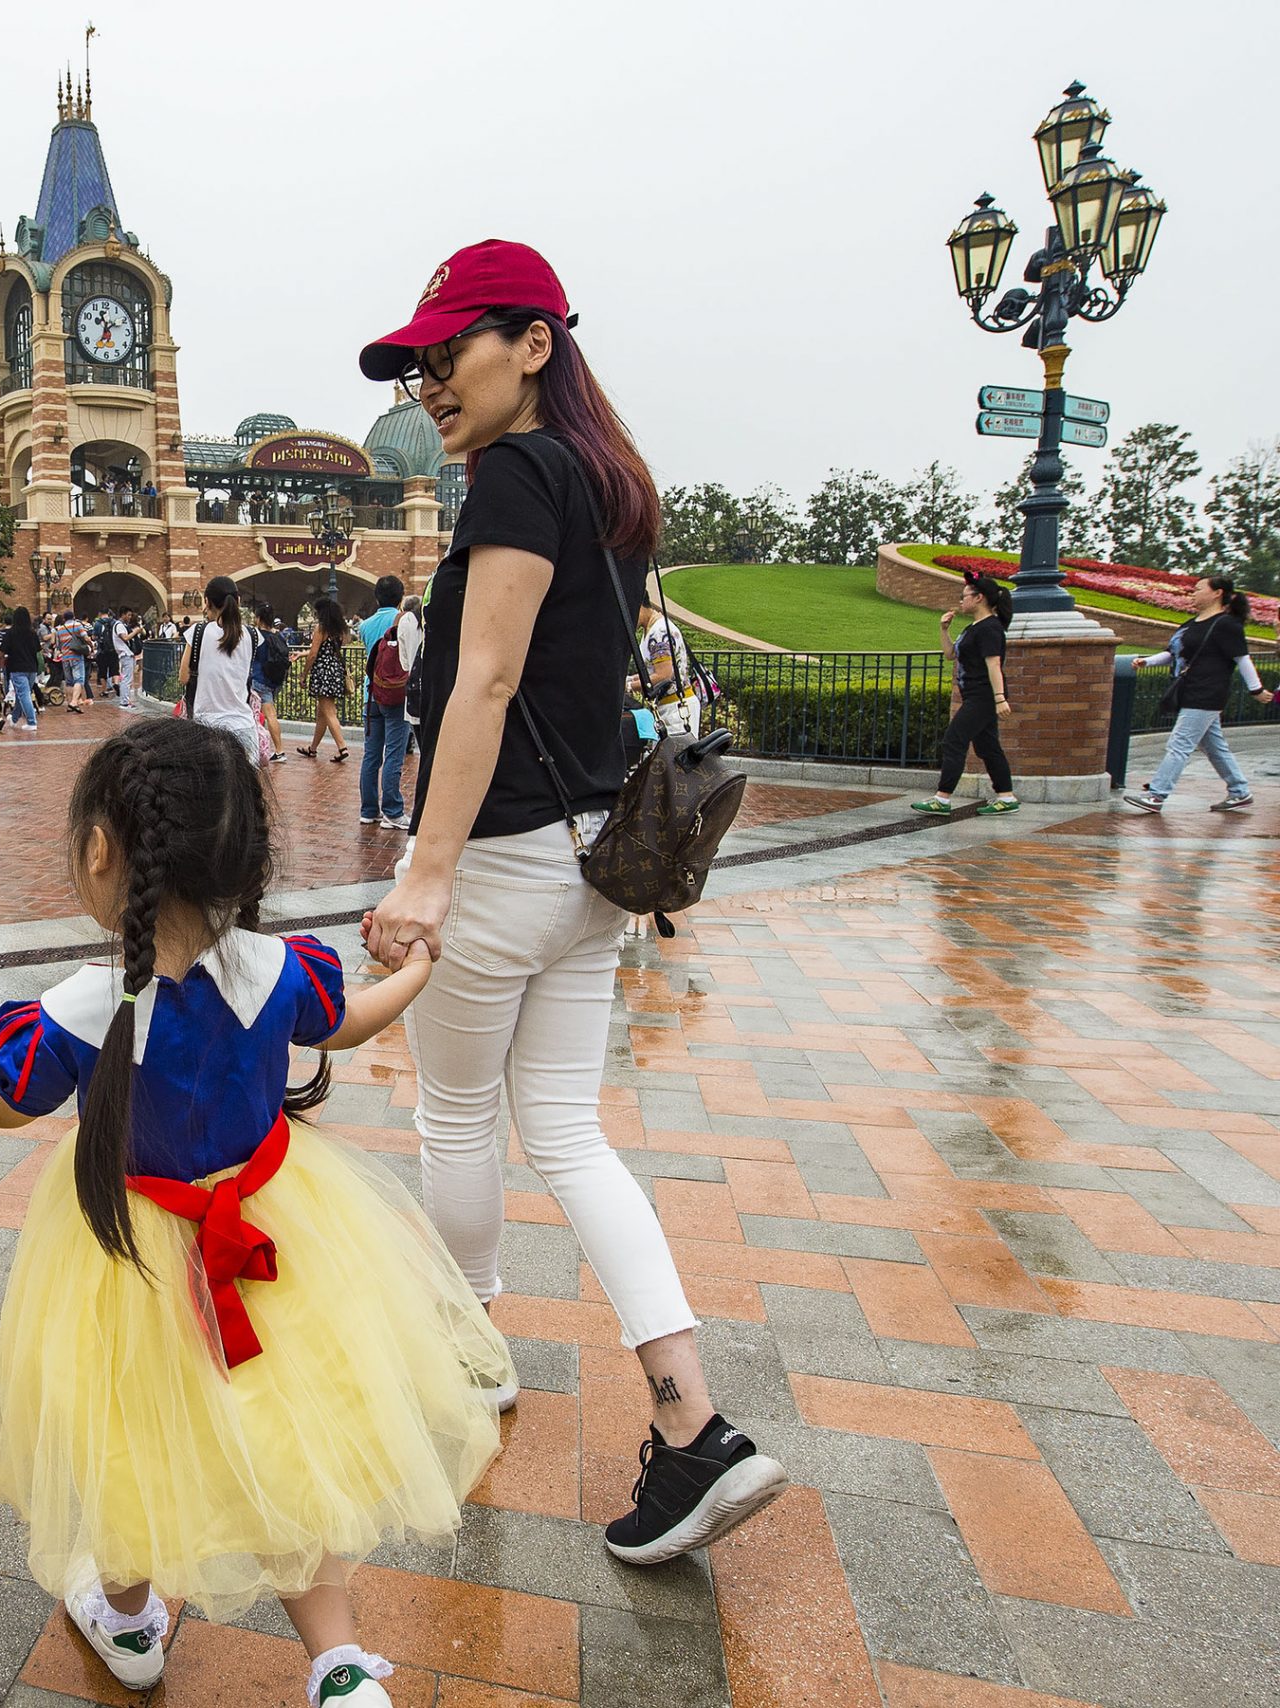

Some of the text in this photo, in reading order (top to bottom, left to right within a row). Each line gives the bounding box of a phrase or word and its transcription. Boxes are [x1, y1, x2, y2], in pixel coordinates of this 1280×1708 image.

[92, 303, 98, 311] 11
[101, 301, 110, 310] 12
[83, 312, 93, 320] 10
[122, 316, 128, 324] 2
[80, 324, 86, 332] 9
[125, 328, 130, 337] 3
[84, 336, 90, 344] 8
[122, 341, 127, 349] 4
[93, 346, 99, 354] 7
[114, 349, 120, 357] 5
[103, 351, 110, 359] 6
[272, 448, 352, 467] DISNEYLAND
